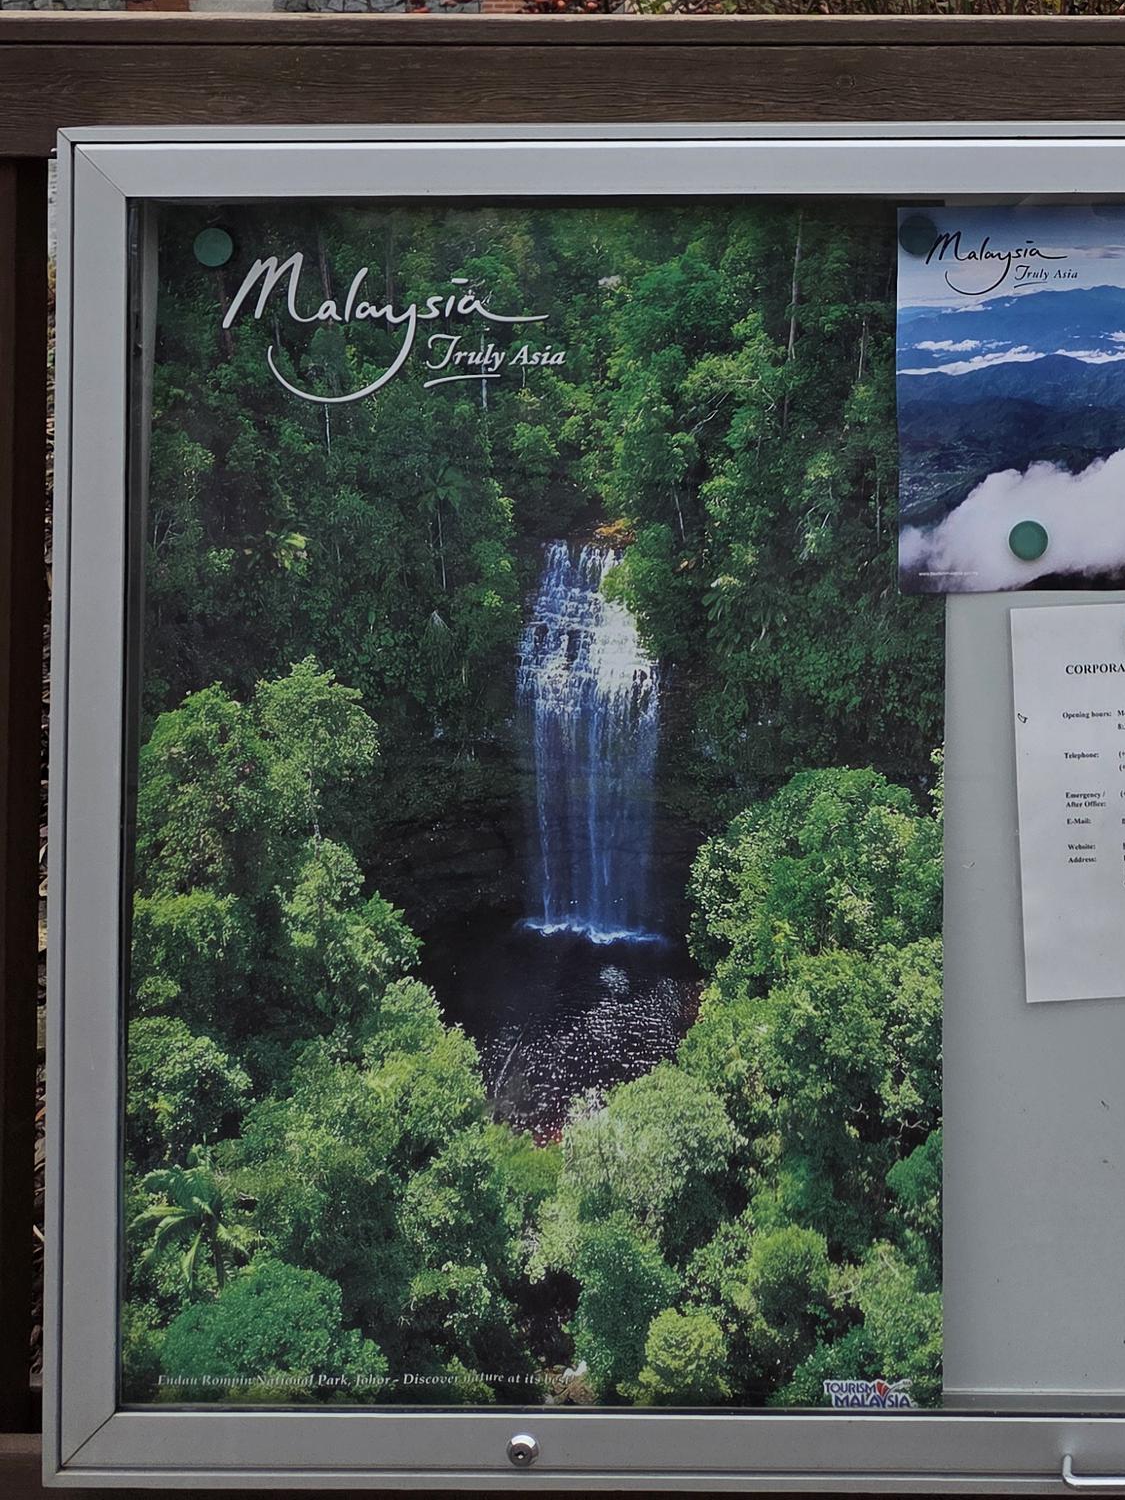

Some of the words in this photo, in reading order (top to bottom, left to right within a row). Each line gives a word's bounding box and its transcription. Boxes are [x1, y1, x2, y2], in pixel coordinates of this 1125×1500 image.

[925, 230, 1068, 296] Malaysia
[1014, 264, 1050, 281] Truly
[1053, 268, 1079, 280] Asia
[222, 251, 549, 402] Malaysia
[425, 334, 505, 371] Truly
[508, 344, 566, 366] Asia
[1062, 711, 1090, 720] Opening
[1091, 710, 1112, 718] hours:
[1064, 752, 1100, 761] Telephone:
[1065, 791, 1101, 800] Emergency
[1065, 800, 1083, 808] After
[1084, 800, 1107, 808] Office:
[1066, 817, 1092, 825] E-Mail:
[1067, 843, 1096, 851] Website:
[1068, 856, 1097, 864] Address:
[158, 1375, 198, 1386] Endau
[202, 1375, 252, 1388] Rompin
[256, 1374, 313, 1386] National
[317, 1374, 351, 1388] Park,
[354, 1373, 391, 1388] Johor
[403, 1373, 458, 1385] Discover
[463, 1372, 504, 1384] nature
[507, 1374, 520, 1384] at
[524, 1373, 540, 1384] its
[825, 1381, 876, 1394] TOURISM
[835, 1394, 911, 1408] MALAYSIA
